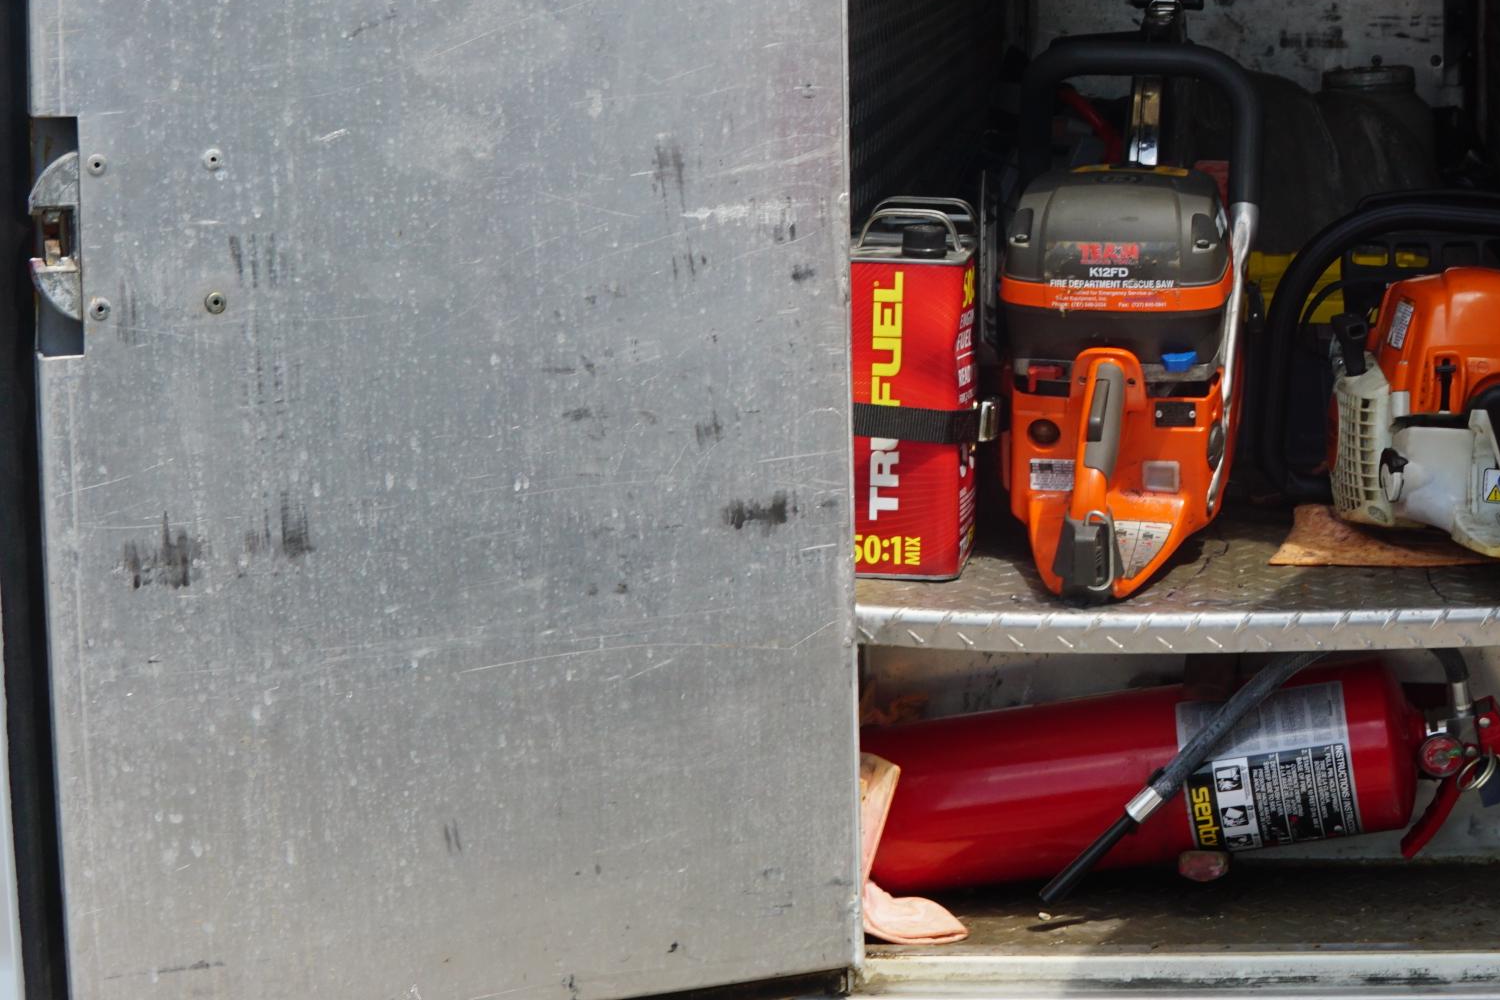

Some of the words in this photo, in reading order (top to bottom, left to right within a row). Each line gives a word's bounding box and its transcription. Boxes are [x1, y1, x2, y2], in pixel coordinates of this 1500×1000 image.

[1089, 267, 1129, 278] K12FD
[1050, 279, 1067, 289] FIRE
[1068, 279, 1121, 289] DEPARTMENT
[1122, 280, 1154, 289] RESCUE
[1155, 280, 1174, 289] SAW
[905, 536, 921, 566] MIX
[1295, 757, 1303, 771] BASE
[1324, 753, 1332, 766] PULL
[1334, 744, 1351, 798] INSTRUCTIONS
[1191, 785, 1220, 846] sentry
